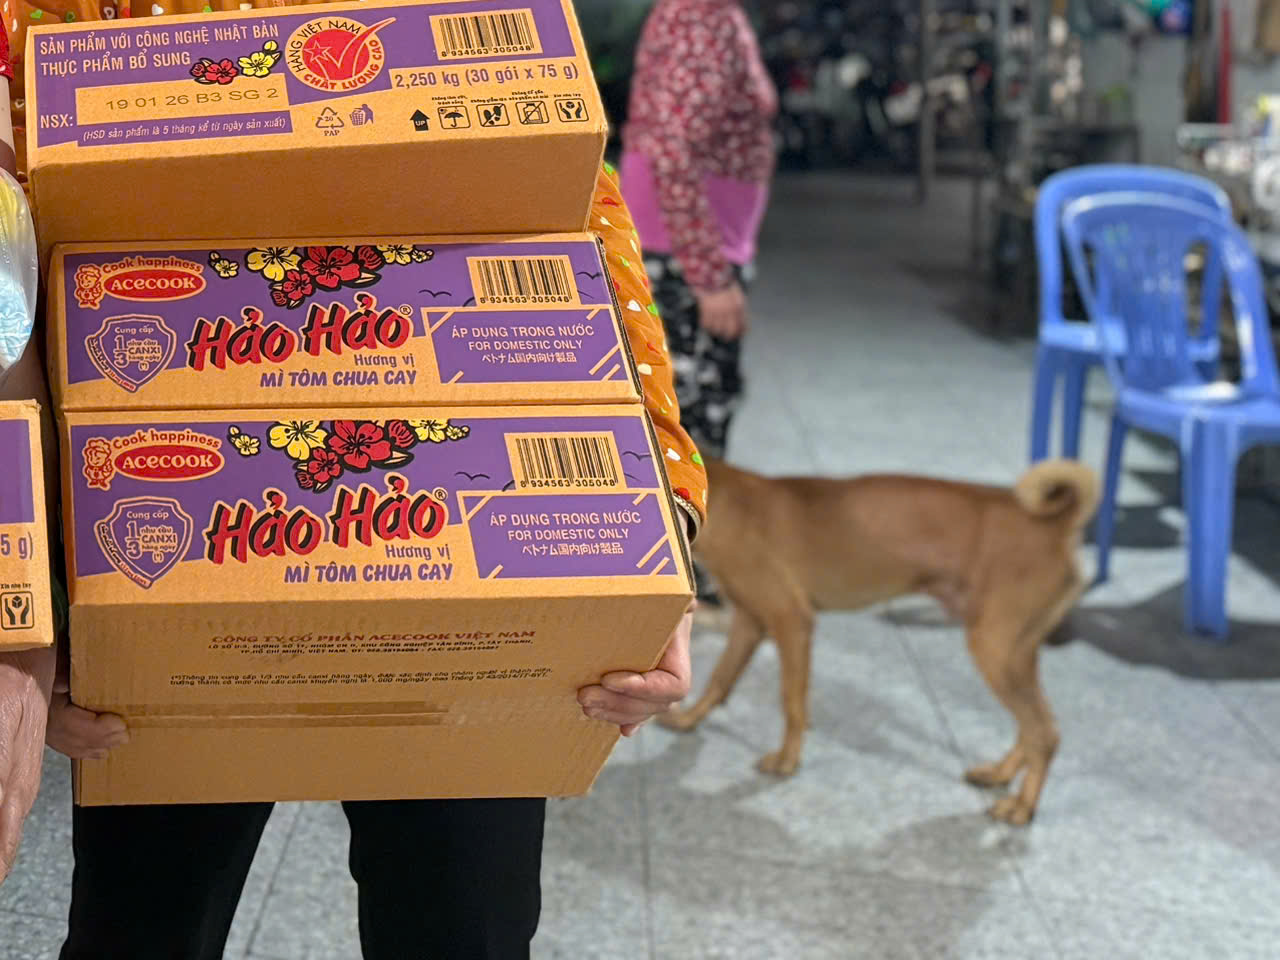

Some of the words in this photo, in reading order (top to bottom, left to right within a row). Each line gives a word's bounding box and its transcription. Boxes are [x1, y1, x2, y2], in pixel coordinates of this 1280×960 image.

[40, 36, 68, 55] SẢN
[70, 31, 106, 53] PHẨM
[110, 32, 131, 50] VỚI
[136, 30, 170, 47] CÔNG
[174, 26, 209, 46] NGHỆ
[214, 25, 248, 44] NHẬT
[253, 21, 279, 39] BẢN
[288, 40, 306, 72] HÀNG
[297, 22, 323, 38] VIỆT
[328, 20, 361, 34] NAM
[41, 59, 78, 77] THỰC
[83, 52, 124, 72] PHẨM
[129, 48, 148, 69] BỔ
[153, 51, 191, 68] SUNG
[304, 73, 337, 90] CHẤT
[341, 63, 379, 90] LƯỢNG
[369, 39, 382, 61] CAO
[394, 72, 437, 89] 2,250
[442, 71, 460, 87] kg
[465, 68, 489, 86] (30
[495, 66, 518, 83] gói
[525, 69, 534, 79] x
[538, 65, 558, 78] 75
[563, 62, 579, 79] g)
[106, 98, 129, 111] 19
[135, 96, 156, 109] 01
[165, 94, 189, 106] 26
[196, 91, 222, 104] B3
[228, 89, 260, 101] SG
[266, 88, 279, 99] 2
[40, 114, 74, 129] NSX:
[103, 257, 133, 274] Cook
[137, 256, 203, 273] happiness
[187, 307, 295, 371] Hảo
[302, 293, 411, 356] Hảo
[452, 324, 468, 339] ÁP
[472, 326, 508, 341] DỤNG
[511, 326, 555, 337] TRONG
[560, 323, 594, 336] NƯỚC
[469, 340, 490, 351] FOR
[493, 340, 551, 350] DOMESTIC
[554, 339, 583, 349] ONLY
[354, 353, 397, 369] Hương
[402, 353, 414, 368] vị
[260, 369, 283, 387] MÌ
[288, 369, 328, 386] TÔM
[333, 370, 379, 386] CHUA
[384, 370, 417, 385] CAY
[114, 431, 146, 450] Cook
[150, 429, 220, 449] happiness
[575, 479, 615, 487] 305048
[126, 511, 150, 520] Cung
[152, 508, 169, 520] cấp
[206, 490, 321, 564] Hảo
[332, 475, 446, 548] Hảo
[490, 512, 508, 527] ÁP
[512, 513, 550, 530] DỤNG
[553, 513, 600, 525] TRONG
[605, 510, 641, 523] NƯỚC
[142, 534, 176, 543] CANXI
[508, 530, 531, 541] FOR
[534, 529, 595, 540] DOMESTIC
[598, 529, 629, 539] ONLY
[18, 532, 35, 560] g)
[386, 543, 432, 560] Hương
[436, 543, 450, 560] vị
[284, 563, 310, 583] MÌ
[314, 563, 357, 582] TÔM
[362, 564, 412, 582] CHUA
[418, 563, 452, 581] CAY
